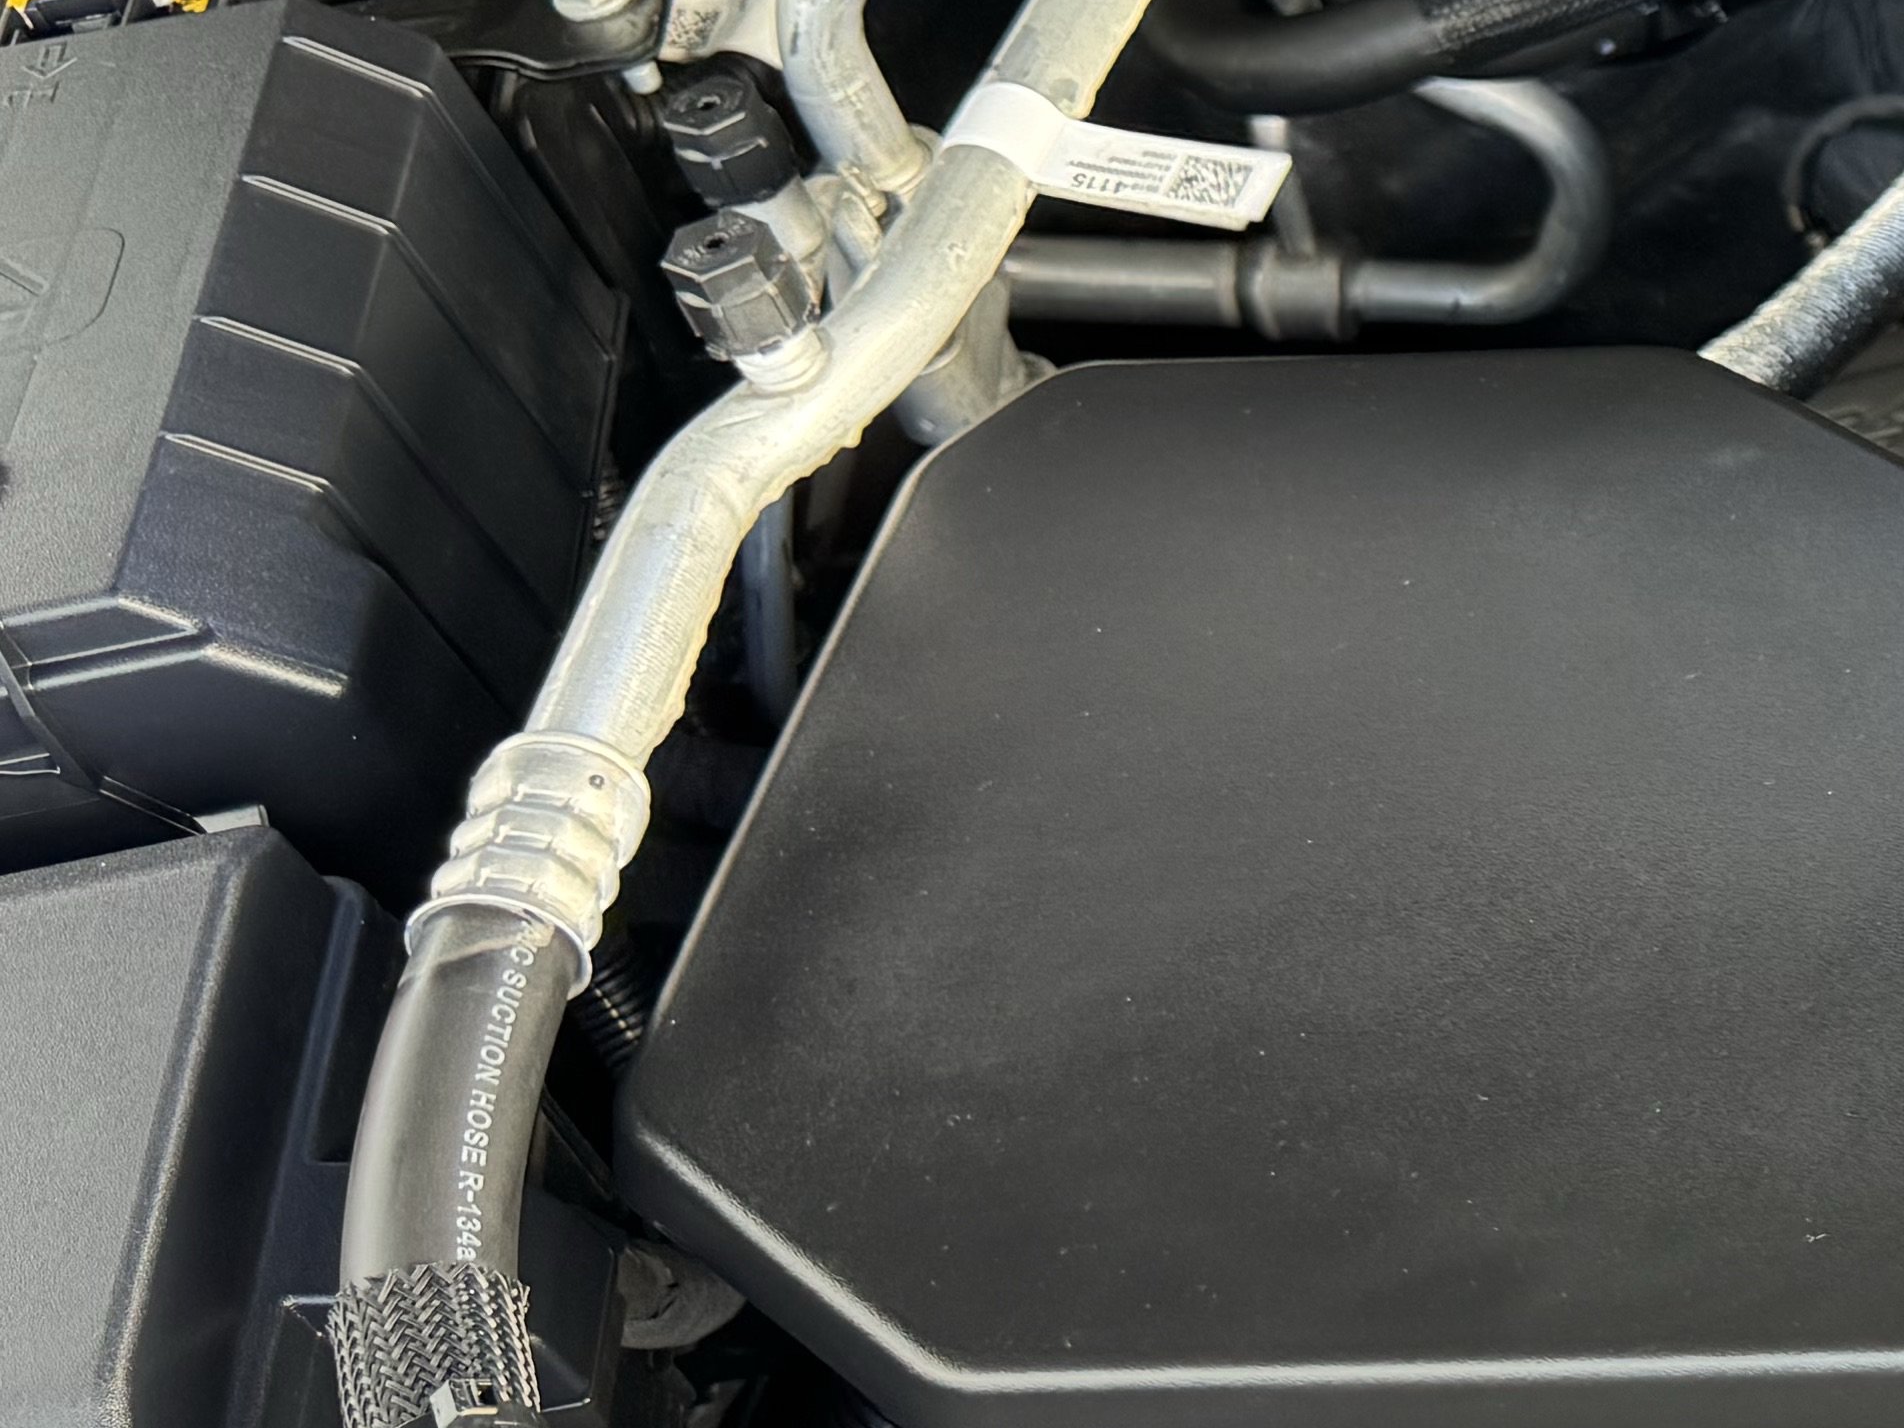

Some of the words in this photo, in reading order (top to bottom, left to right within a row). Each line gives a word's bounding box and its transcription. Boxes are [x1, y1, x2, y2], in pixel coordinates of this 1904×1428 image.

[473, 969, 527, 1086] SUCTION
[460, 1088, 498, 1167] HOSE
[455, 1170, 484, 1262] R-134a
